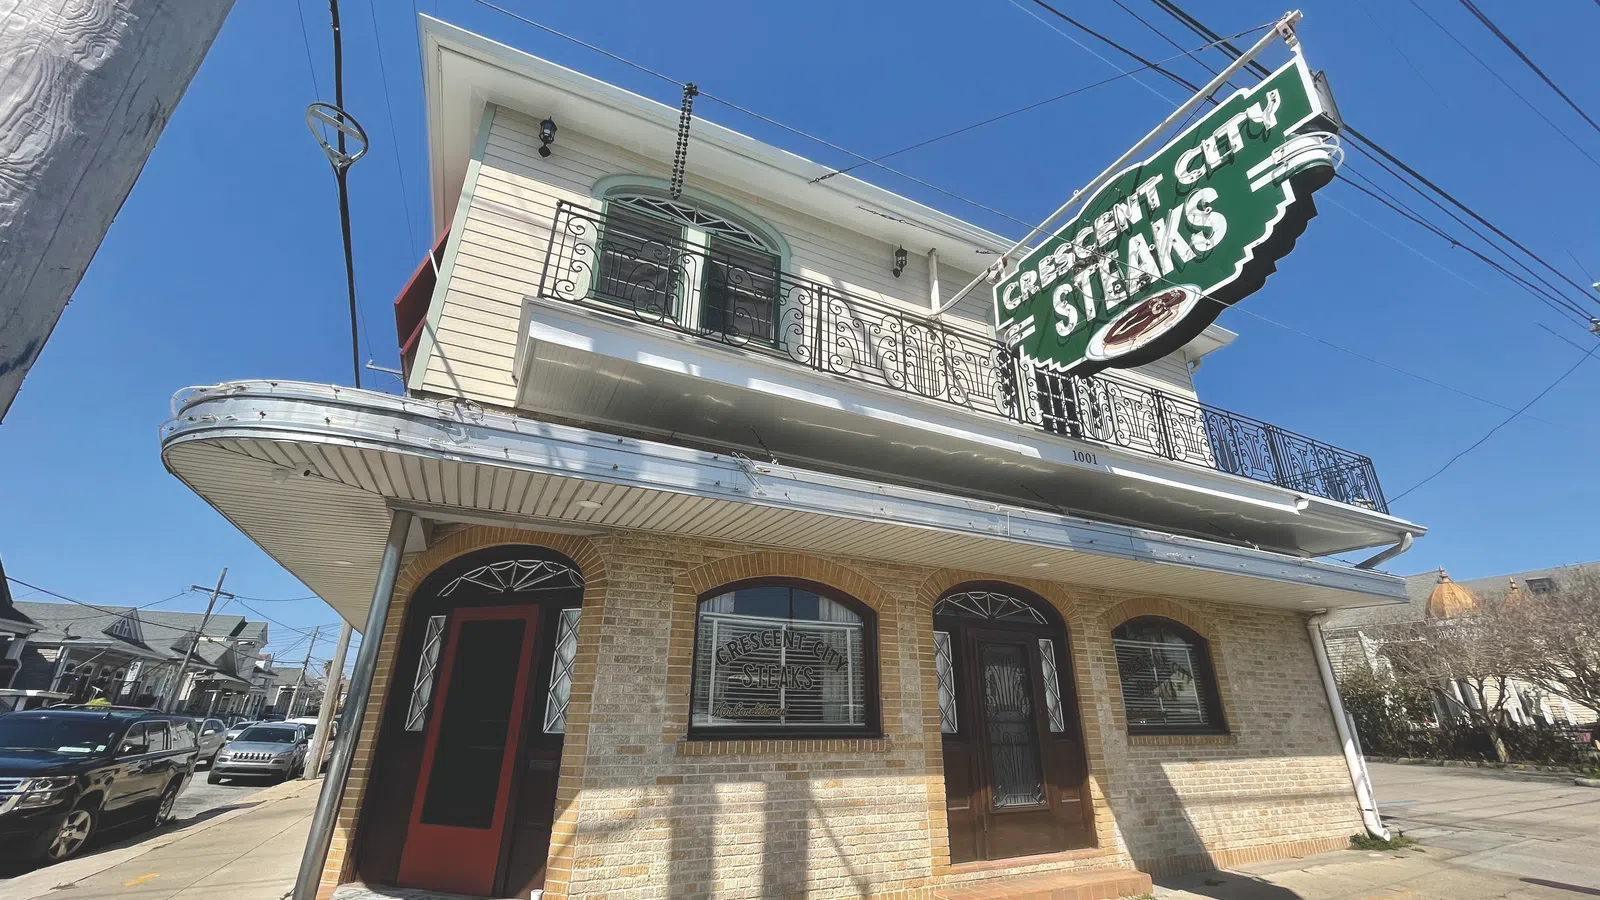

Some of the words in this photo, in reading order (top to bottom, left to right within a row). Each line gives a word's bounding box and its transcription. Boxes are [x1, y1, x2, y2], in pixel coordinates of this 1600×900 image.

[1002, 173, 1164, 311] CRESCENT
[1174, 88, 1282, 185] CITY
[1052, 187, 1228, 338] STEAKS
[1072, 450, 1098, 465] 1001
[715, 628, 807, 666] CRESCENT
[812, 640, 849, 673] CITY
[742, 663, 814, 690] STEAKS
